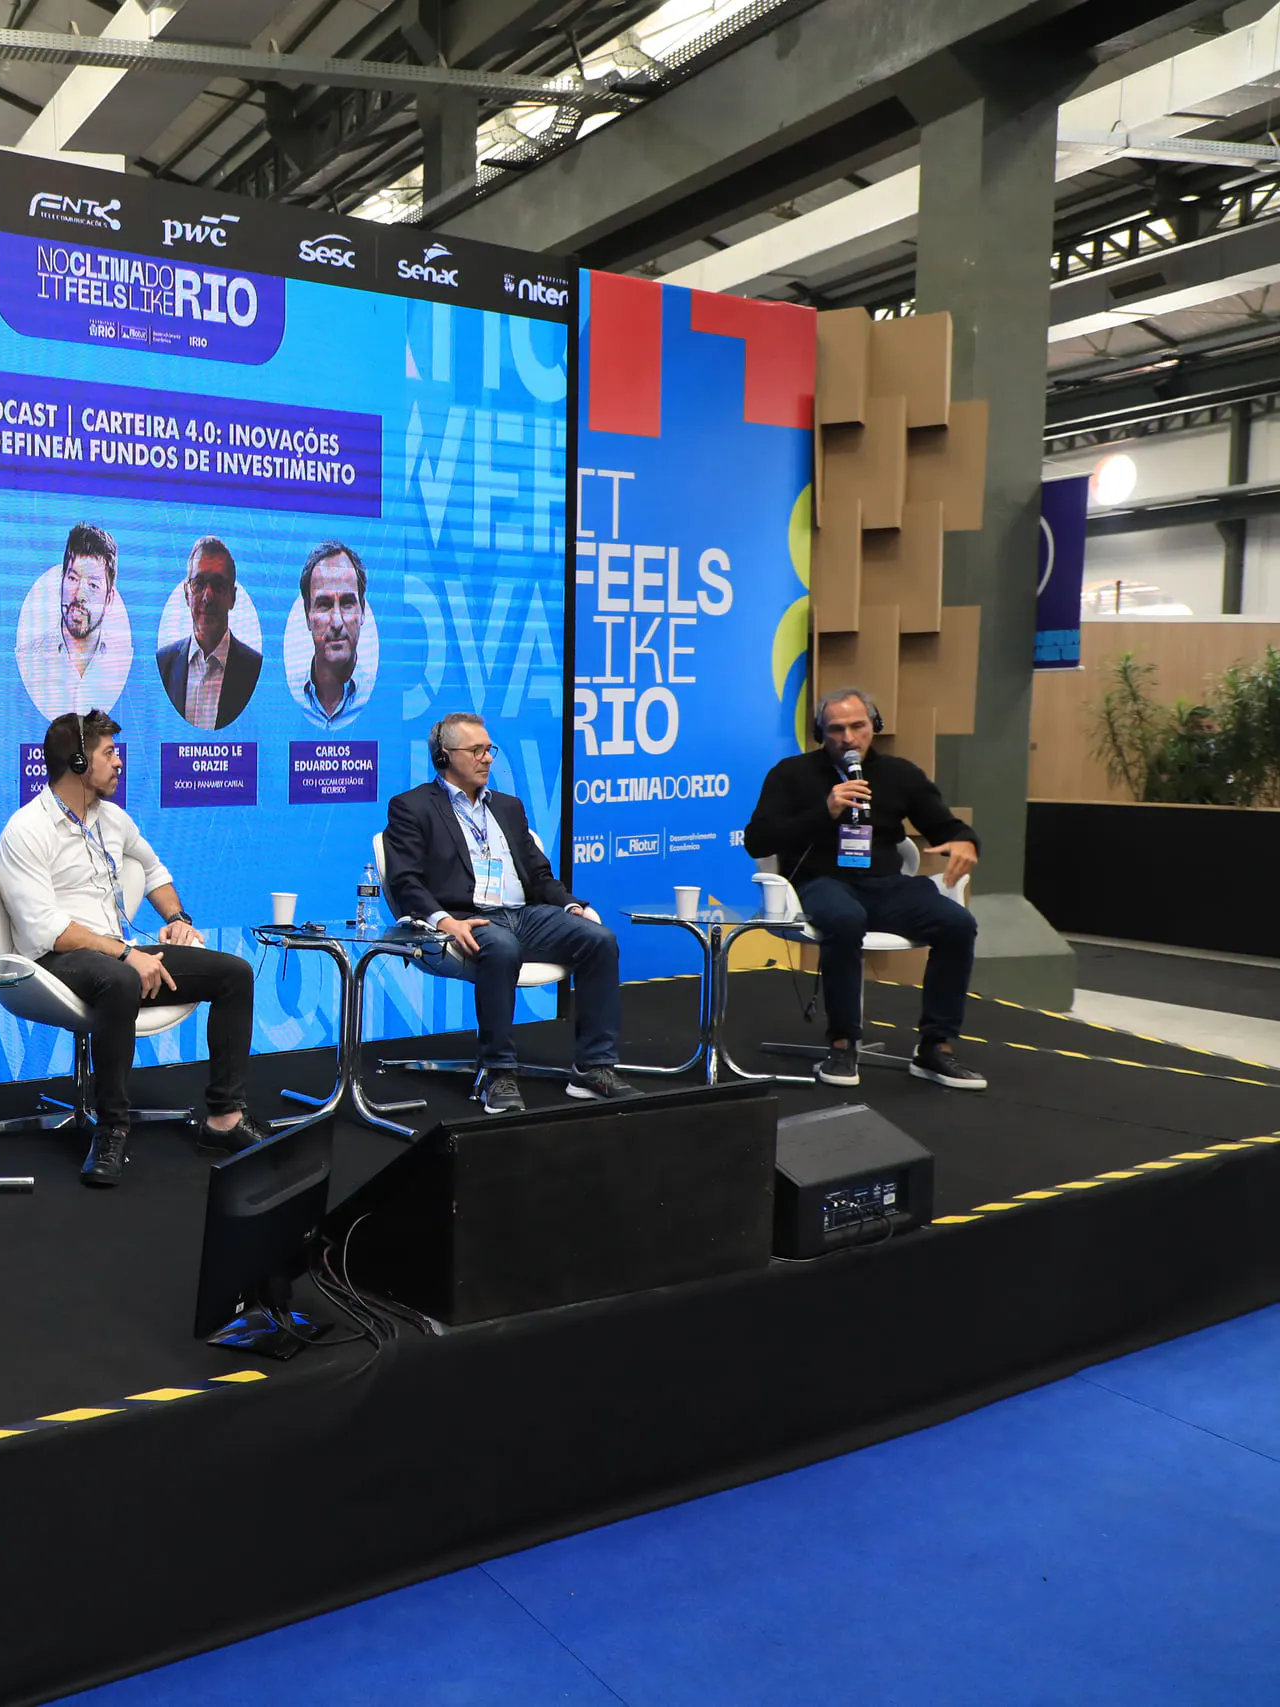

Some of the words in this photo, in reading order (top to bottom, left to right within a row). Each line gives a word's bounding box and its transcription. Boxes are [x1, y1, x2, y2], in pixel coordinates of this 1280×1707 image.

[162, 217, 227, 247] pwc
[398, 259, 459, 287] Senac
[175, 267, 258, 328] RIO
[81, 408, 180, 441] CARTEIRA
[185, 420, 222, 444] 4.0:
[229, 423, 340, 457] INOVAÇÕES
[90, 439, 178, 469] FUNDOS
[184, 449, 210, 472] DE
[216, 452, 356, 485] INVESTIMENTO
[573, 686, 680, 756] RIO
[178, 746, 229, 757] REINALDO
[232, 746, 242, 757] LE
[316, 746, 350, 757] CARLOS
[192, 760, 228, 772] GRAZIE
[294, 760, 339, 772] EDUARDO
[341, 760, 373, 771] ROCHA
[574, 842, 605, 864] RIO
[629, 838, 658, 853] Riotur
